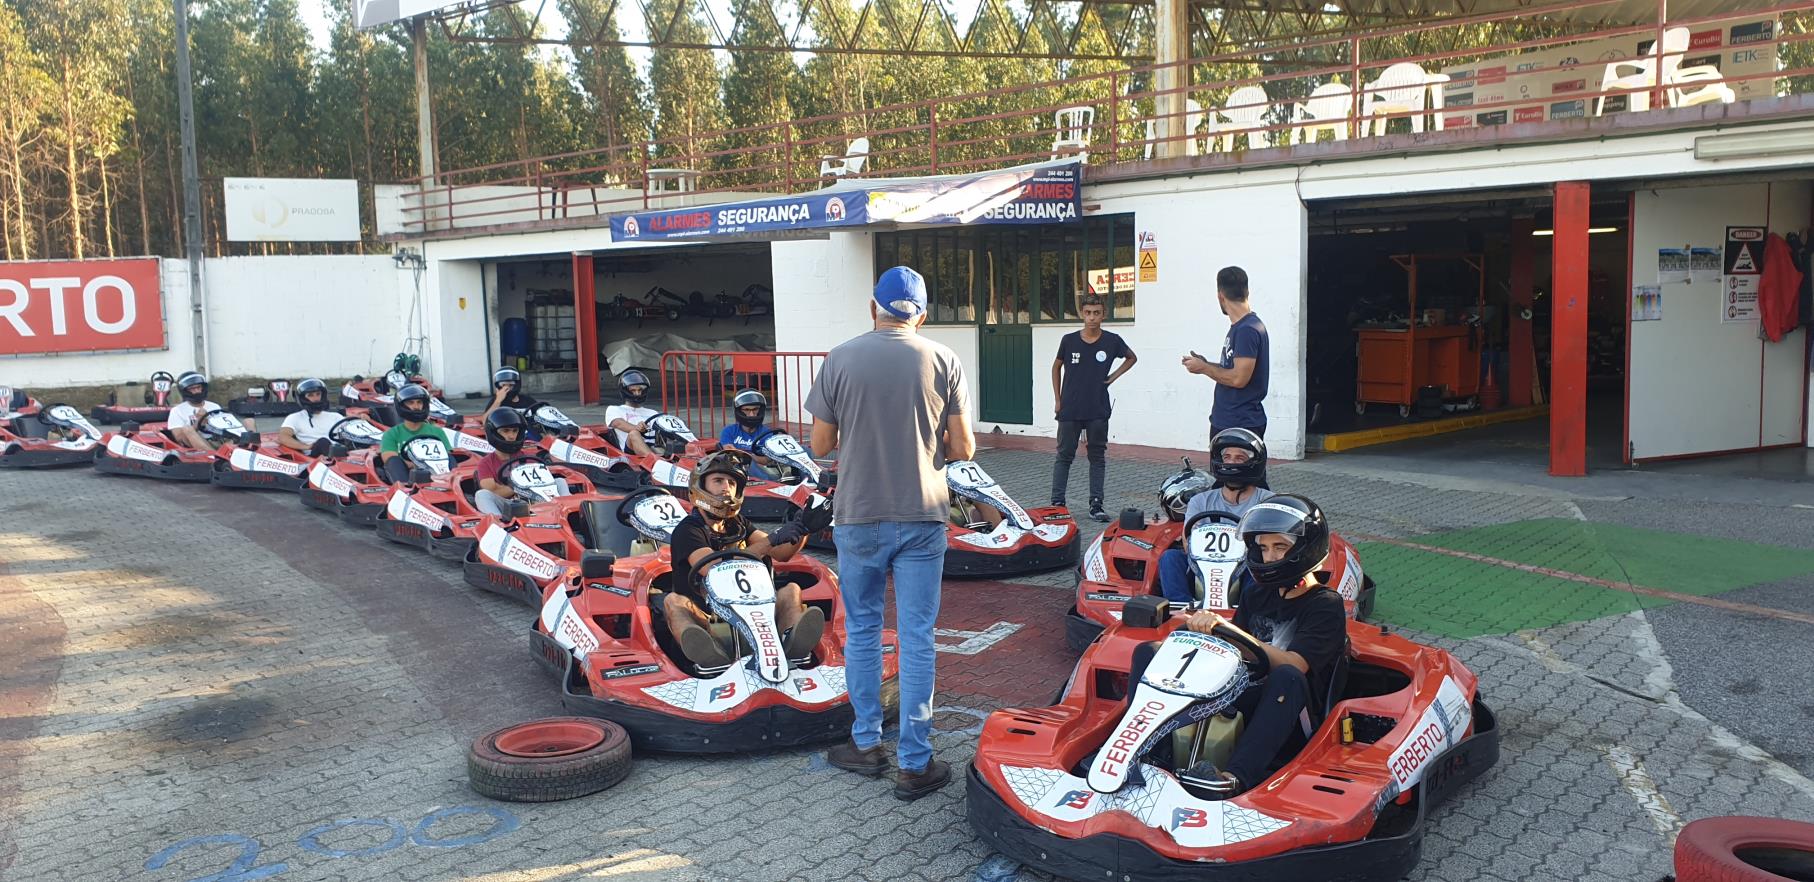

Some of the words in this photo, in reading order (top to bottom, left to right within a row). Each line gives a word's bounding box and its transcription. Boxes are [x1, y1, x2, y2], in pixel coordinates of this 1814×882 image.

[1731, 33, 1772, 45] FERBERTO
[1551, 110, 1584, 119] FERBERTO
[649, 211, 712, 231] ALARMES
[718, 203, 810, 225] SEGURANÇA
[1735, 230, 1758, 239] DANGER
[222, 416, 233, 426] 5
[356, 424, 375, 434] 11
[422, 444, 440, 455] 24
[778, 438, 796, 451] 15
[256, 458, 297, 474] FERBERTO
[572, 449, 608, 467] FERBERTO
[521, 467, 542, 483] 14
[961, 466, 985, 485] 27
[654, 502, 682, 521] 32
[1203, 531, 1230, 553] 20
[507, 545, 554, 578] FERBERTO
[717, 563, 760, 572] EUROINDY
[734, 569, 752, 594] 6
[1210, 567, 1224, 609] ERBERTO
[749, 610, 780, 667] FERBERTO
[1173, 637, 1229, 655] EUROINDY
[1174, 647, 1199, 680] 1
[1099, 700, 1166, 778] FERBERTO
[1391, 722, 1444, 785] ERBERTO
